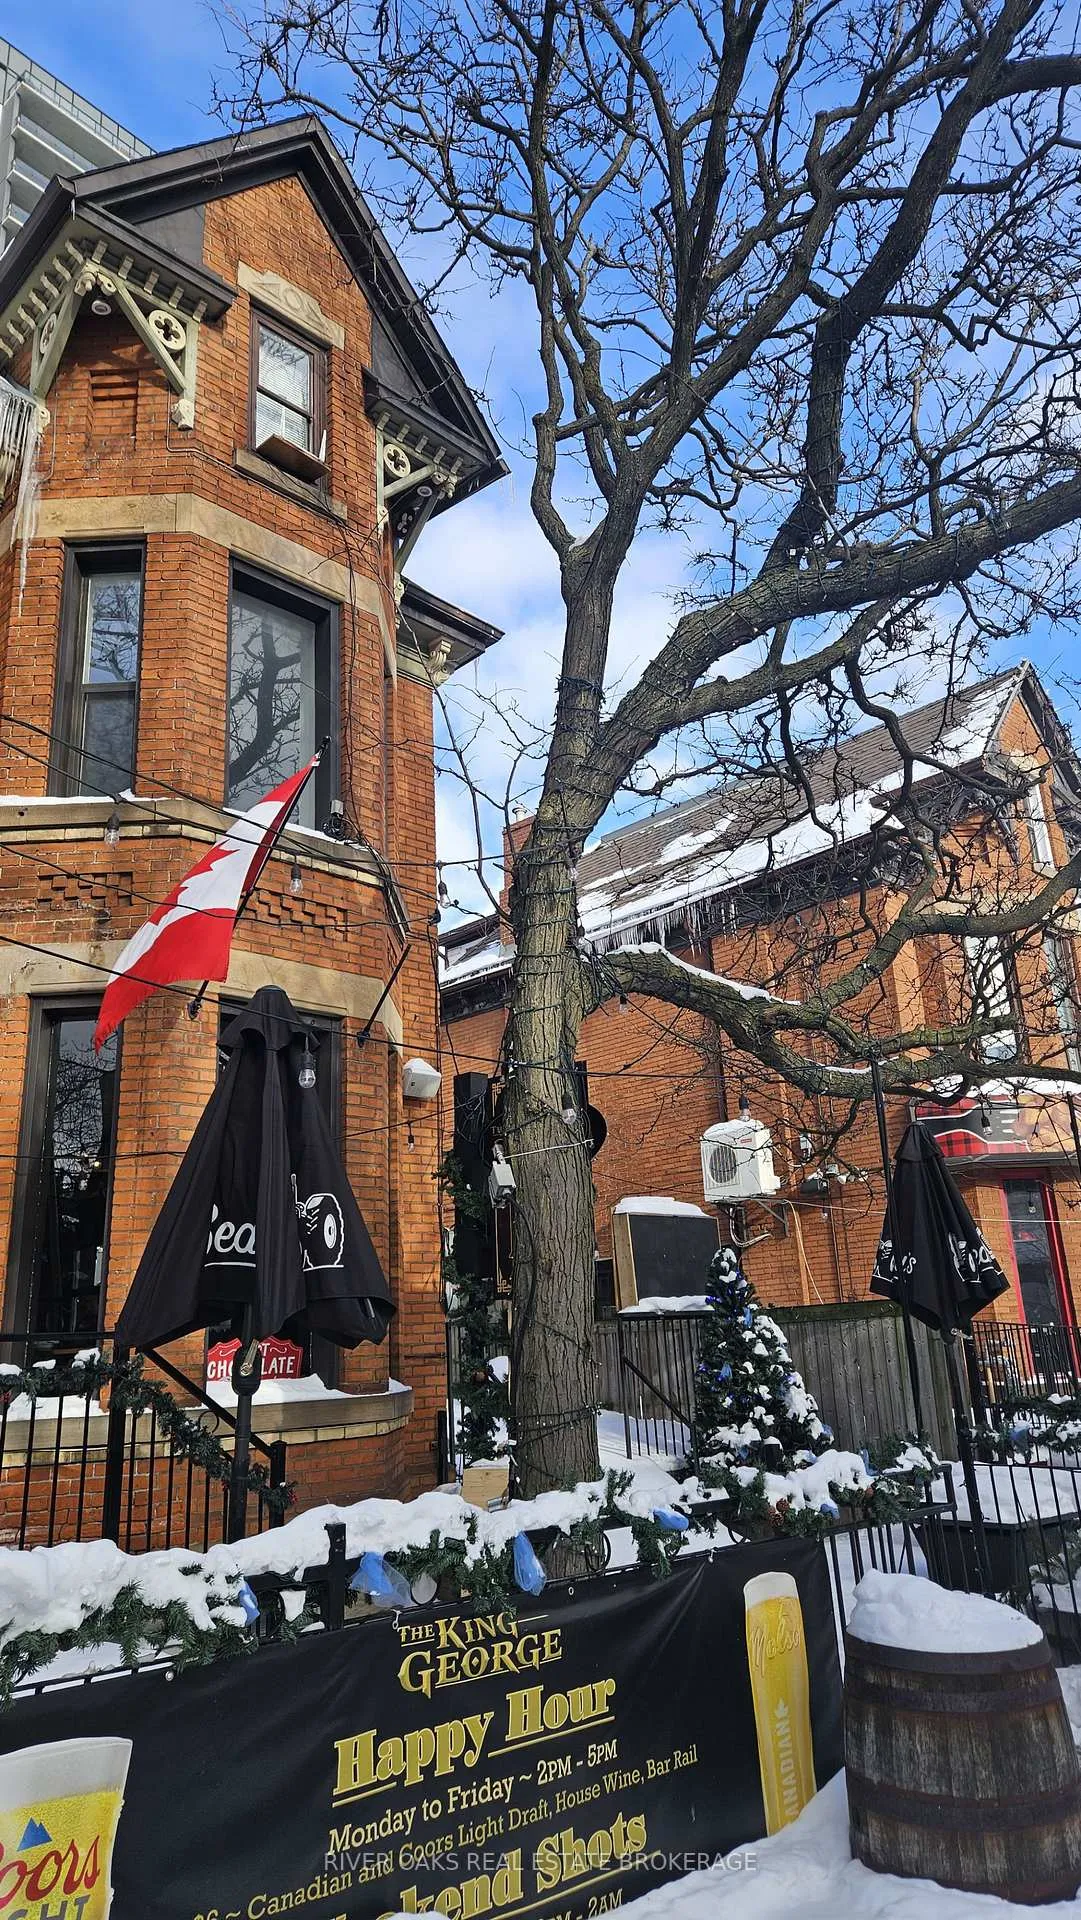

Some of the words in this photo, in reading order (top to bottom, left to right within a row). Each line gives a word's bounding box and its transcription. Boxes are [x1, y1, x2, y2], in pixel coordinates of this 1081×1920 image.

[207, 1356, 296, 1379] CHLATE
[397, 1624, 435, 1643] THE
[435, 1611, 519, 1650] KING
[397, 1628, 563, 1699] GEORGE
[333, 1711, 495, 1796] Happy
[505, 1678, 616, 1742] Hour
[775, 1717, 800, 1816] ANADIAN
[247, 1871, 352, 1920] Canadian
[358, 1850, 394, 1884] and
[400, 1833, 453, 1867] Coors
[458, 1815, 504, 1848] Light
[508, 1799, 552, 1831] Draft,
[554, 1785, 600, 1814] House
[602, 1768, 644, 1795] Wine,
[646, 1757, 671, 1779] Bar
[673, 1743, 698, 1770] Rail
[328, 1805, 416, 1855] Monday
[422, 1799, 442, 1821] to
[447, 1776, 515, 1813] Friday
[537, 1755, 573, 1785] 2PM
[587, 1739, 618, 1768] 5PM
[0, 1834, 100, 1911] oors
[536, 1811, 647, 1893] Shots
